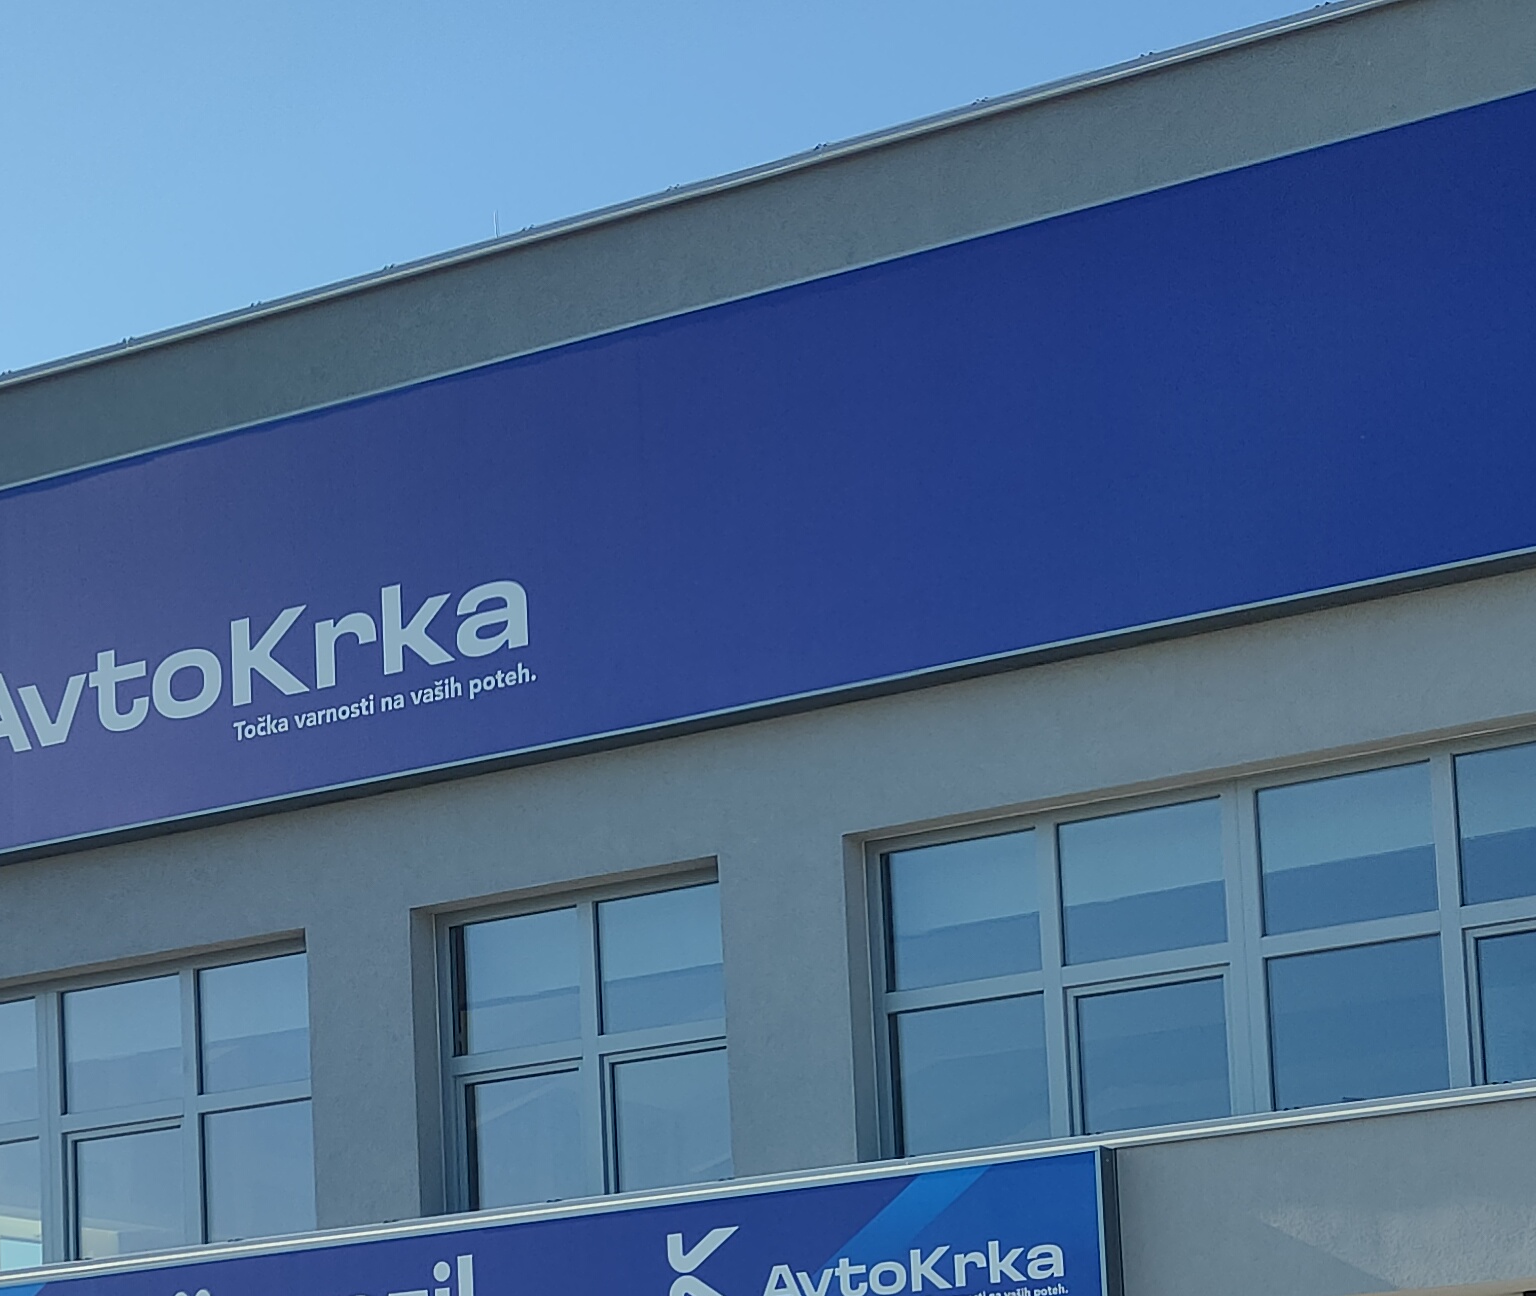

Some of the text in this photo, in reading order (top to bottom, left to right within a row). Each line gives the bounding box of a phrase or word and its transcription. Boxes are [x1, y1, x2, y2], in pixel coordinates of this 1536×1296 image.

[233, 662, 538, 741] Točka varnosti na vaših poteh.
